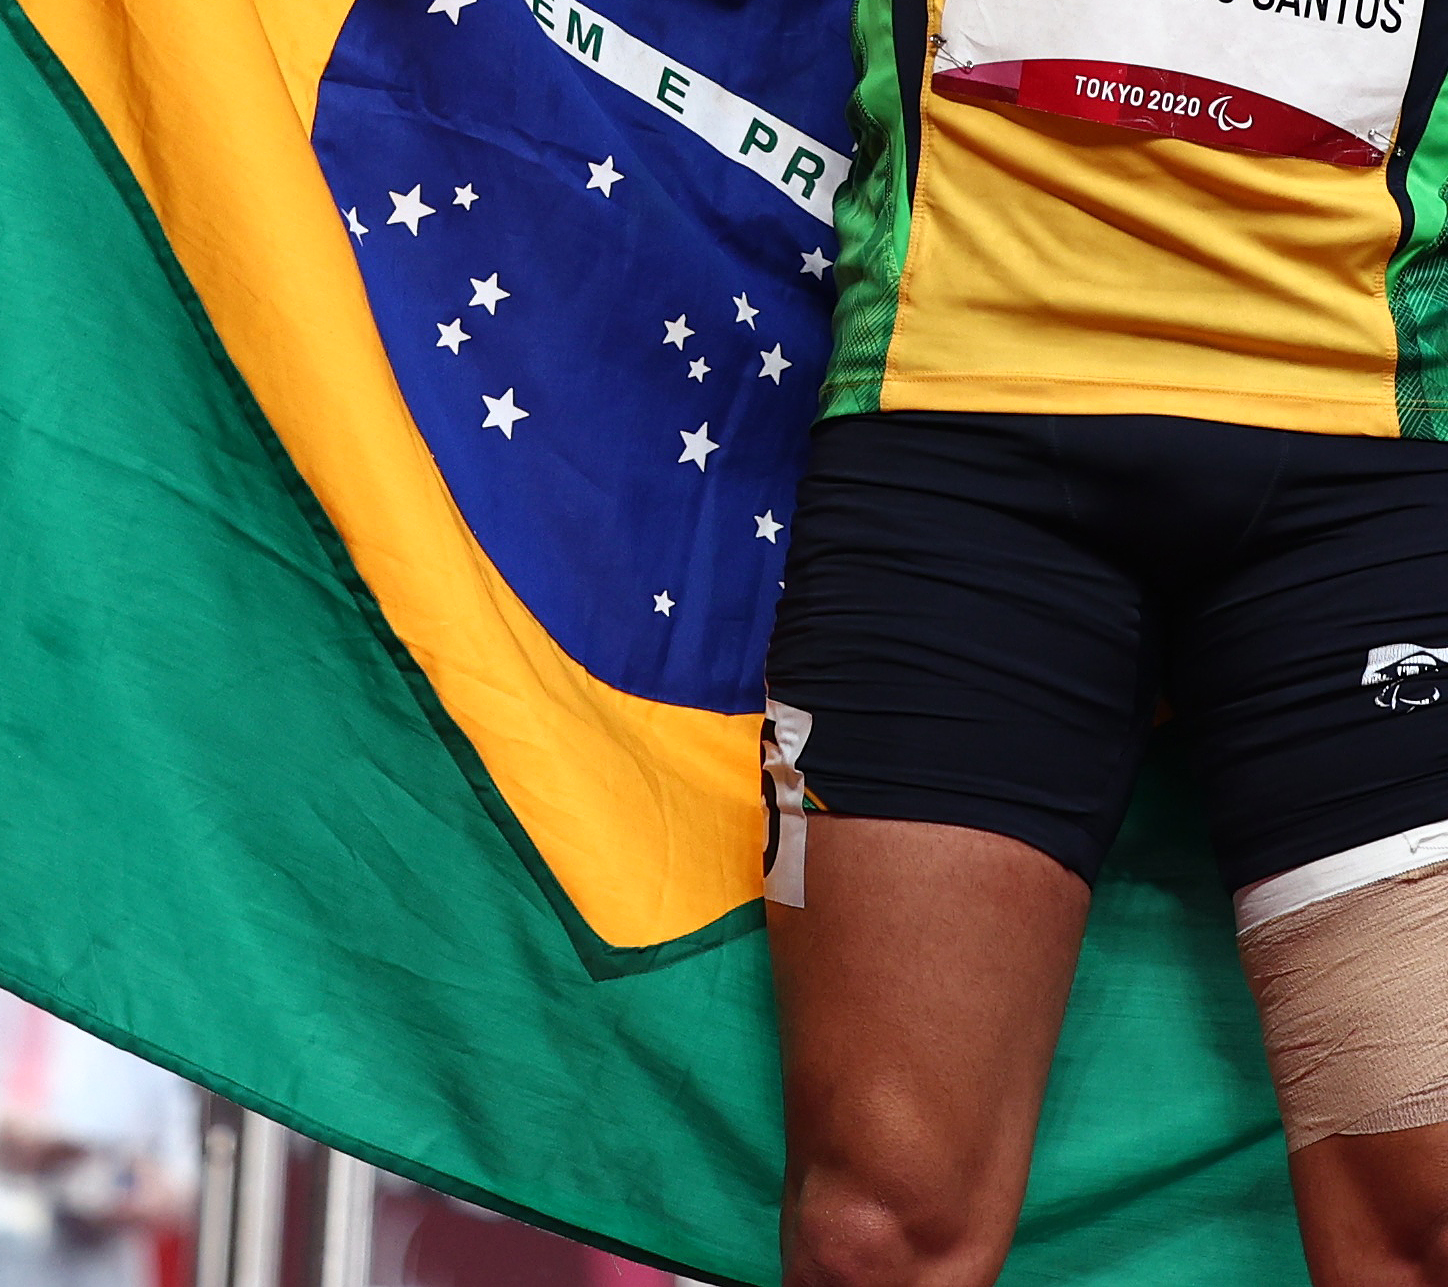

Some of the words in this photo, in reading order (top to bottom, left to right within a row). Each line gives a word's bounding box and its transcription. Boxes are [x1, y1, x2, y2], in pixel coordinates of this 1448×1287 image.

[656, 66, 691, 115] E
[1074, 74, 1145, 108] TOKYO
[1147, 89, 1202, 118] 2020
